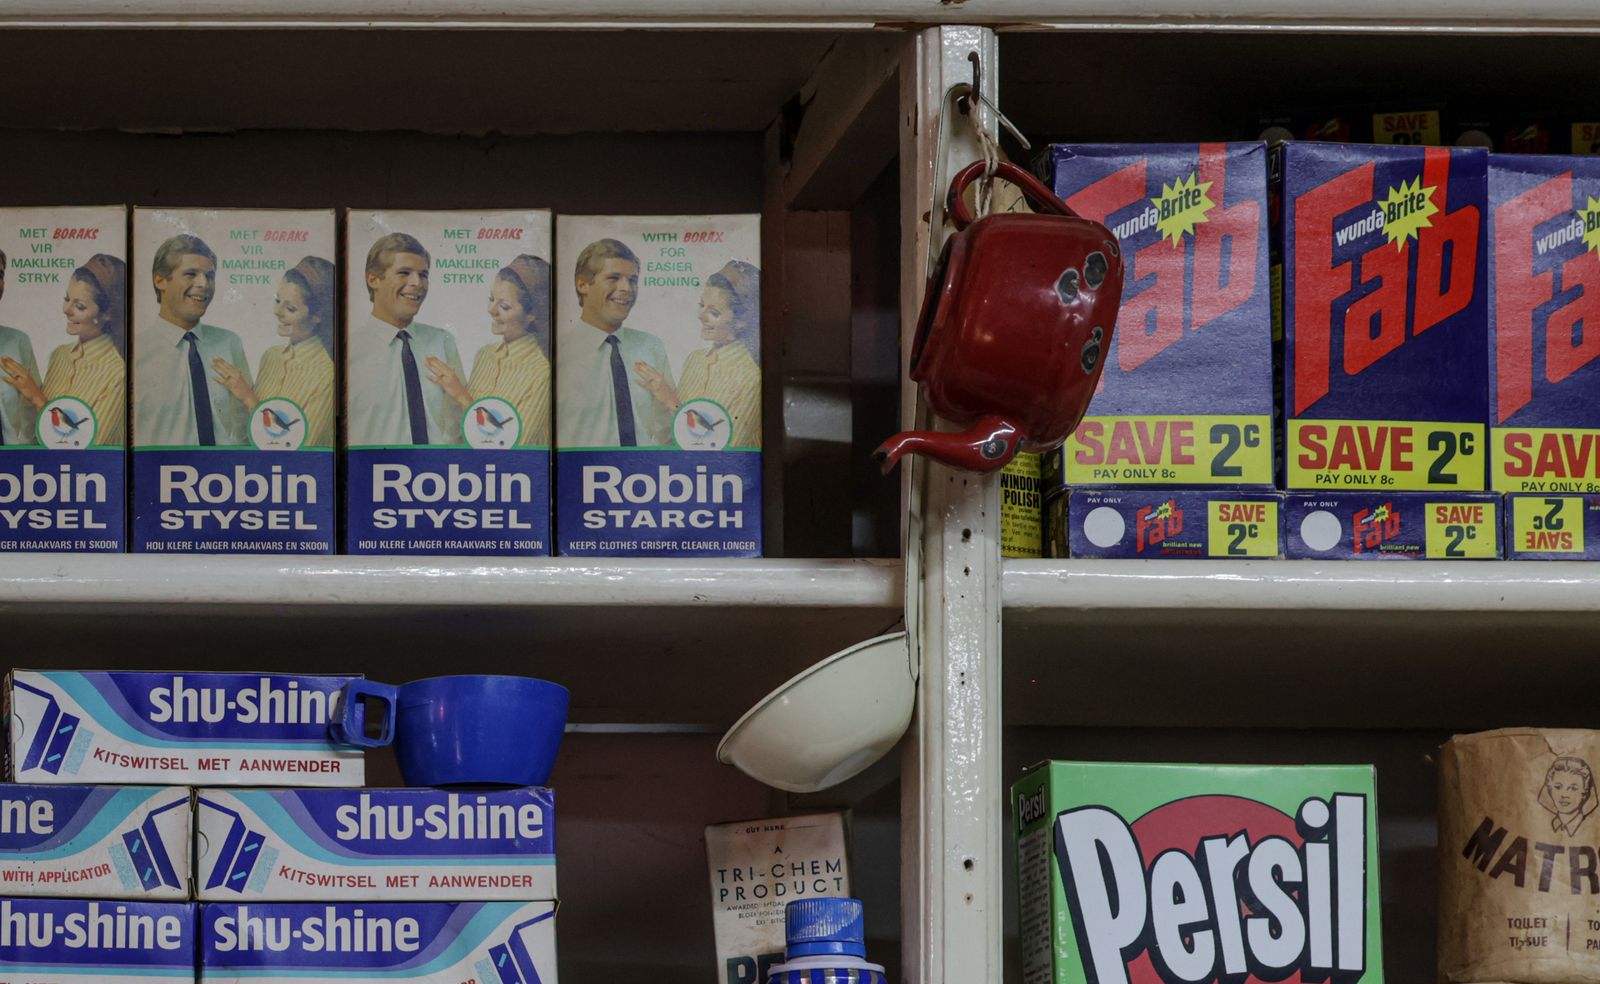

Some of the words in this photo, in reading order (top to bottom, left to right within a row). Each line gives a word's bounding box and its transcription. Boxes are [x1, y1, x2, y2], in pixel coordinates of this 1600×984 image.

[1336, 211, 1385, 246] wunda
[1385, 191, 1427, 222] Brite
[1295, 148, 1479, 416] Fab
[1298, 428, 1414, 471] SAVE
[1316, 474, 1339, 486] PAY
[1342, 474, 1376, 486] ONLY
[336, 796, 544, 842] shu-shine
[2, 869, 34, 882] WITH
[37, 863, 112, 882] APPLICATOR
[279, 865, 376, 888] KITSWITSEL
[386, 875, 419, 888] MET
[428, 875, 533, 888] AANWENDER
[720, 877, 843, 902] PRODUCT
